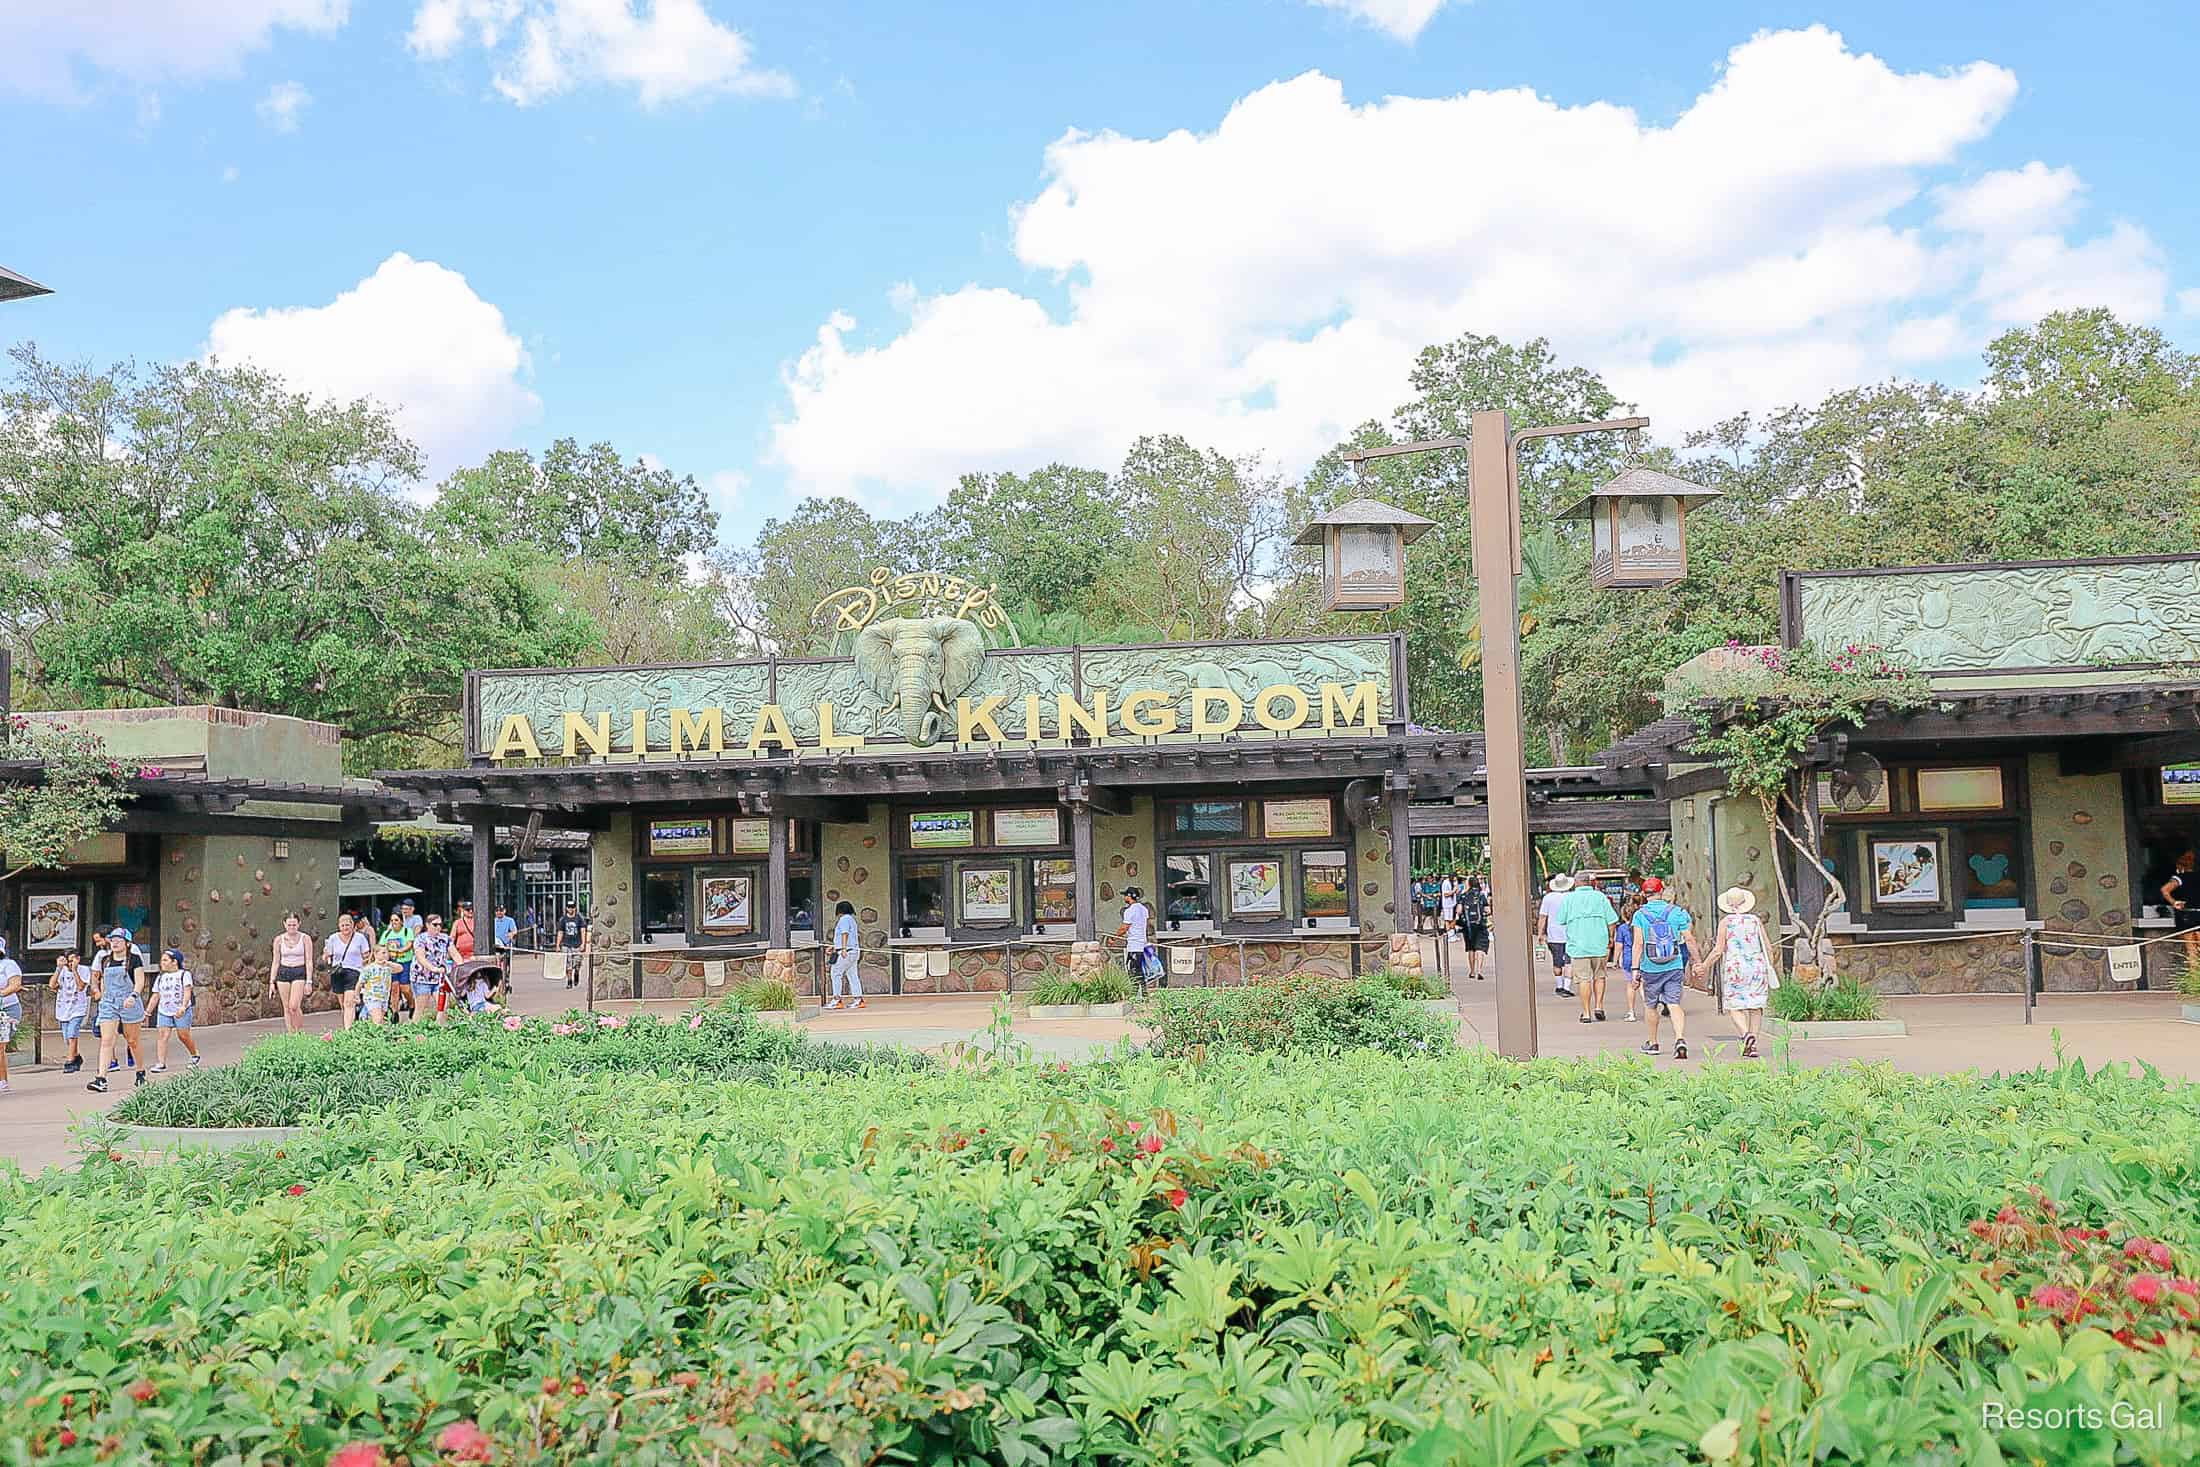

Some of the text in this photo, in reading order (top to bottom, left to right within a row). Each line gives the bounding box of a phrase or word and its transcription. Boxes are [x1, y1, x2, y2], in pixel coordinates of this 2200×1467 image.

[489, 681, 1388, 760] ANIMAL KINGDOM
[2112, 960, 2139, 970] ENTER
